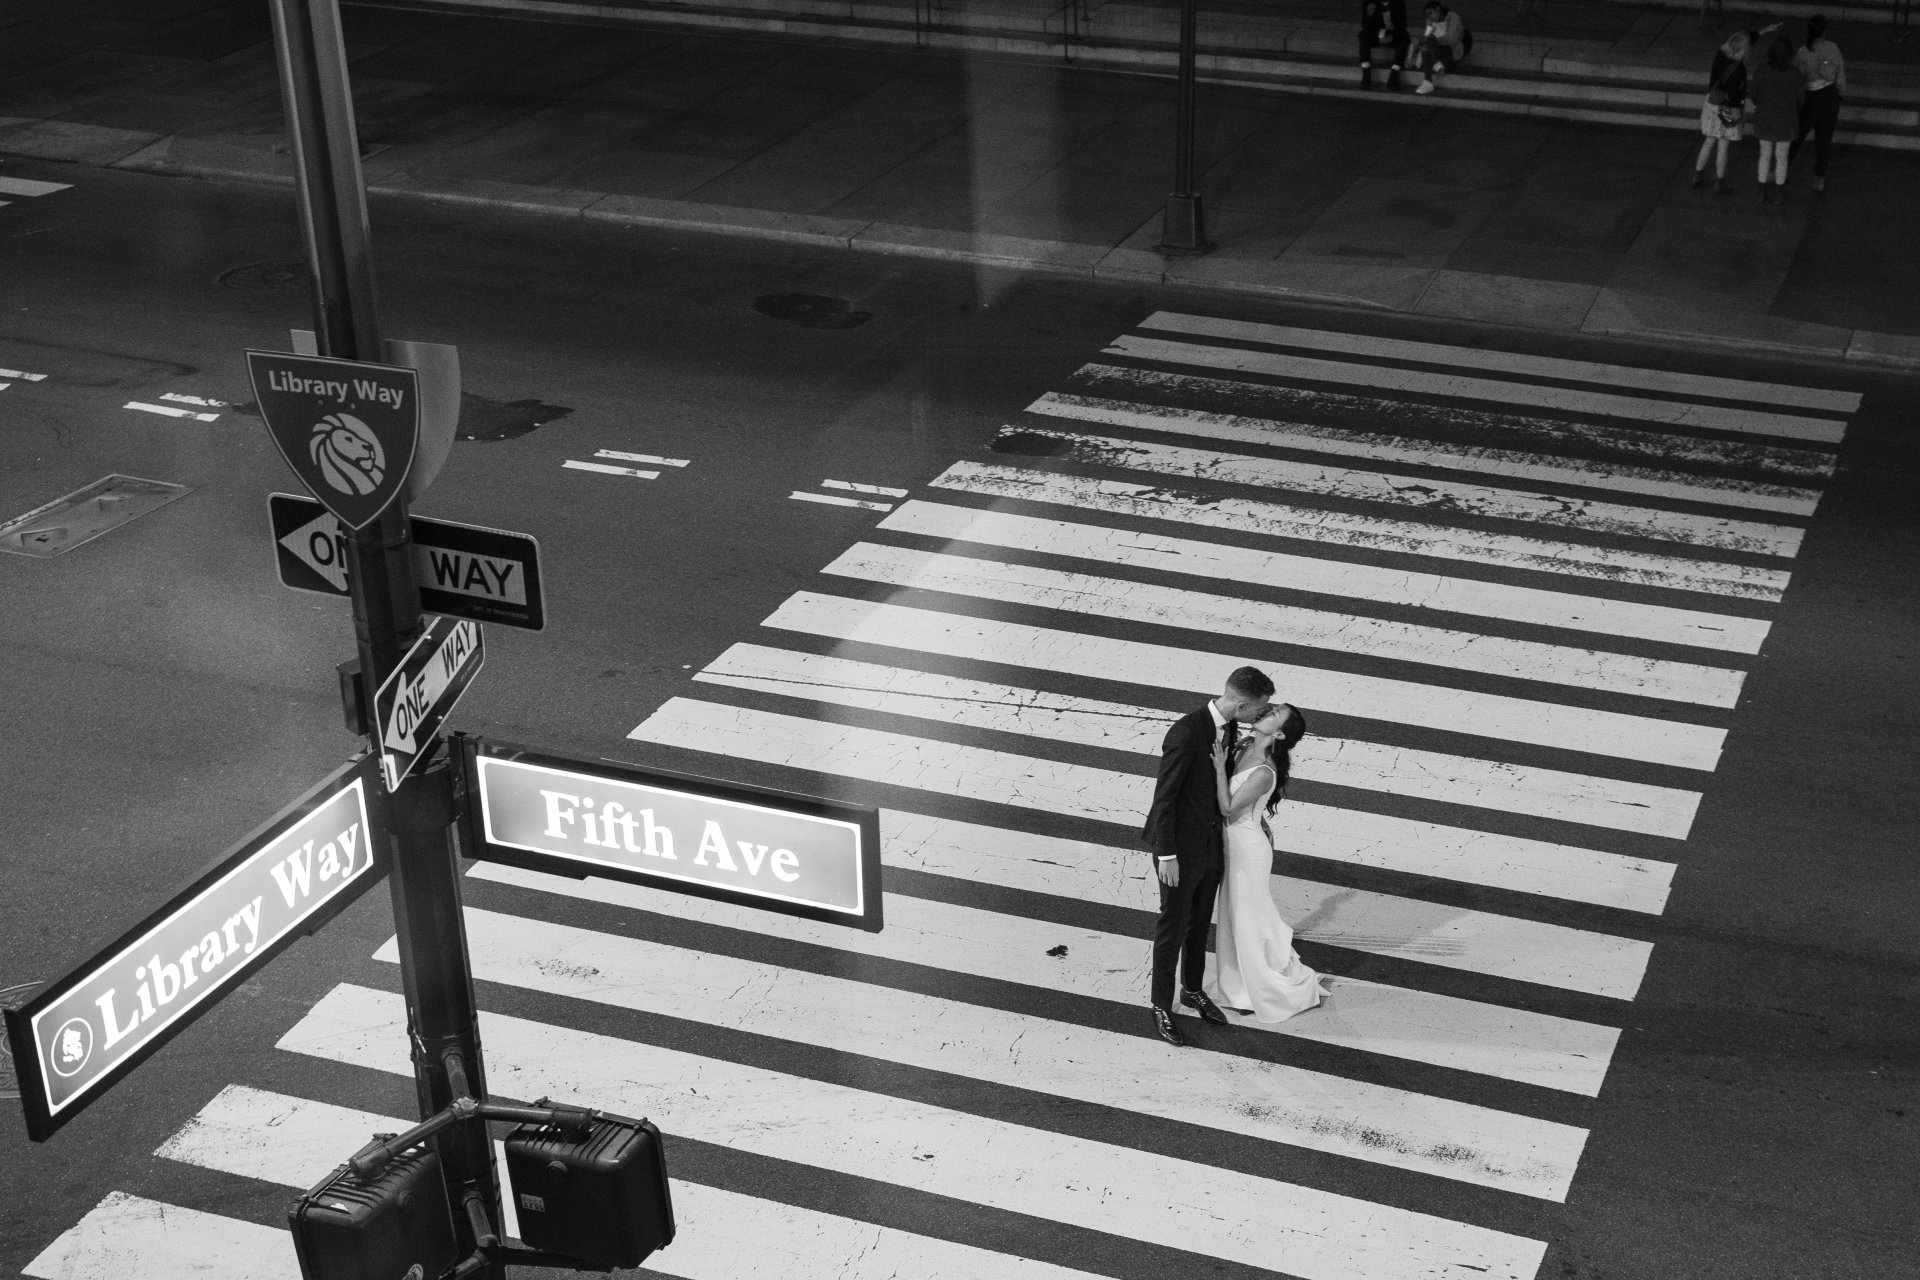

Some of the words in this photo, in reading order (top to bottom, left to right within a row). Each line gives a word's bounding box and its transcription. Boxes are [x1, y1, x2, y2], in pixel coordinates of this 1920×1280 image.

[269, 370, 348, 403] Library
[353, 379, 404, 410] Way
[430, 550, 515, 597] WAY
[396, 675, 430, 741] ONE
[441, 620, 473, 680] WAY
[540, 790, 678, 860] Fifth
[693, 819, 801, 883] Ave
[95, 896, 263, 1051] Library
[270, 823, 359, 909] Way
